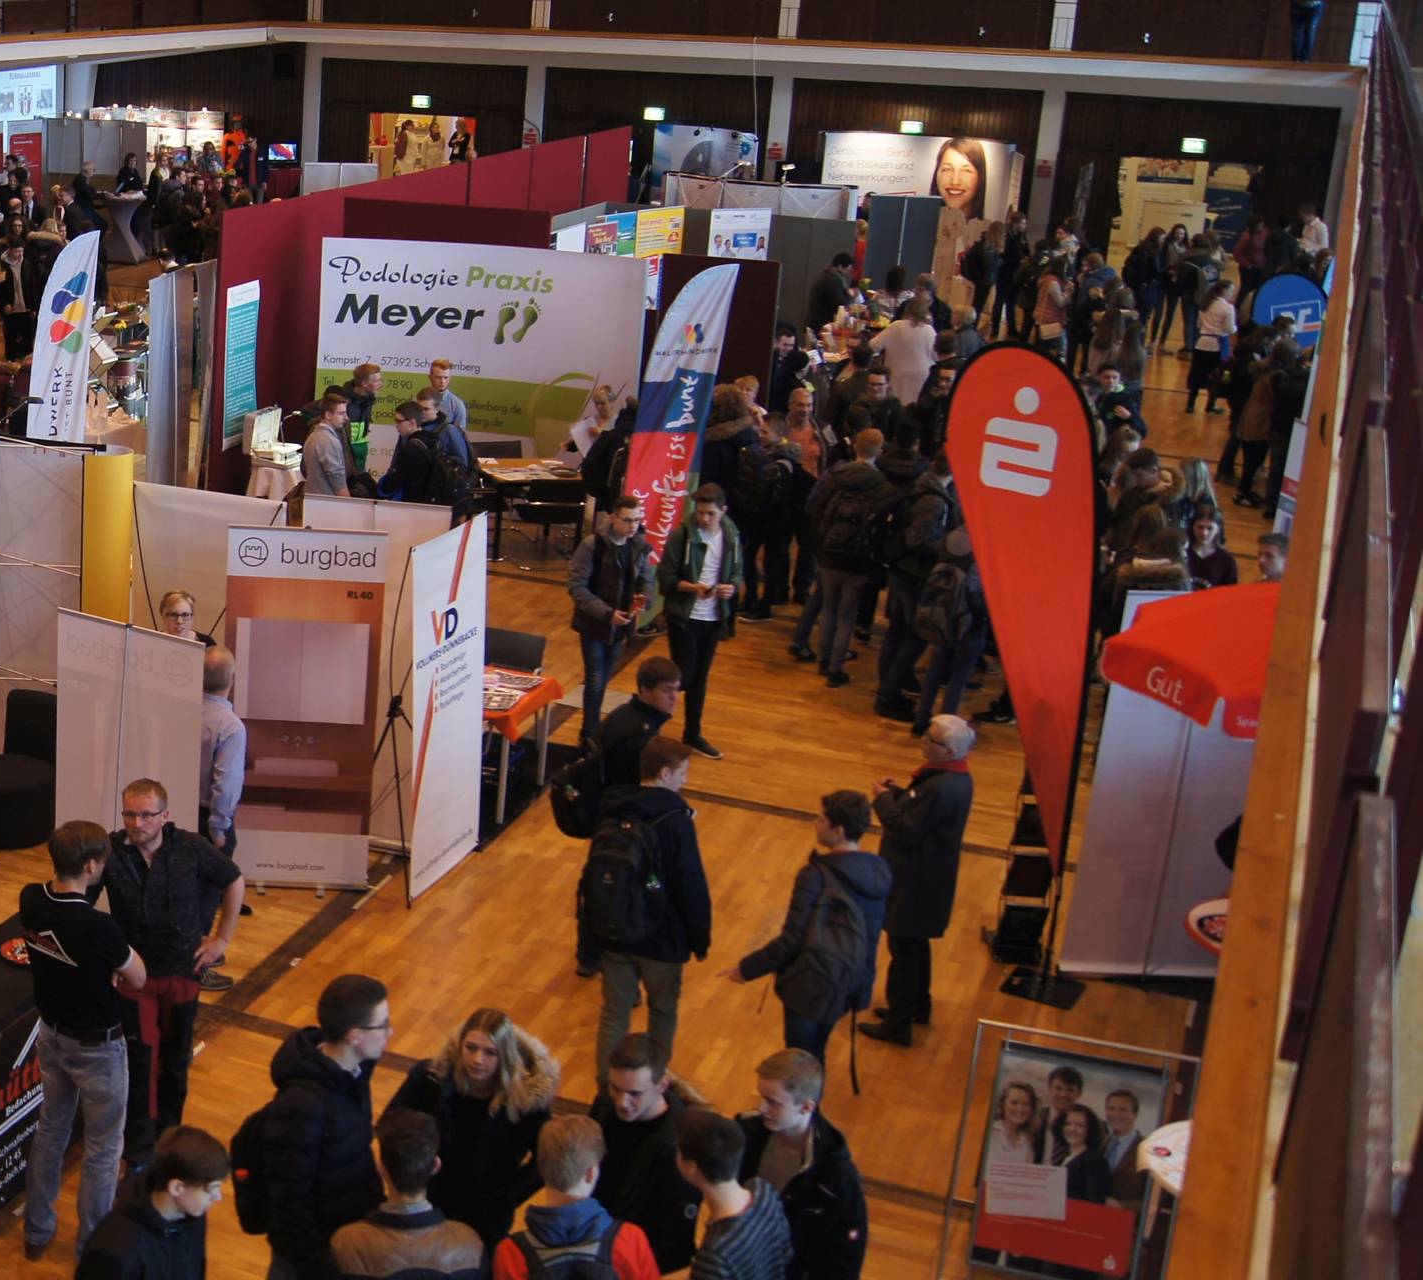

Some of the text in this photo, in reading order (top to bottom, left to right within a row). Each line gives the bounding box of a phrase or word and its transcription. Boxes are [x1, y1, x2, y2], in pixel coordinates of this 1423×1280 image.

[329, 256, 553, 294] Podologie Praxis
[335, 293, 485, 337] Meyer
[381, 356, 412, 368] 57392
[665, 374, 700, 430] bunt
[281, 542, 377, 571] burgbad
[431, 607, 459, 646] VD
